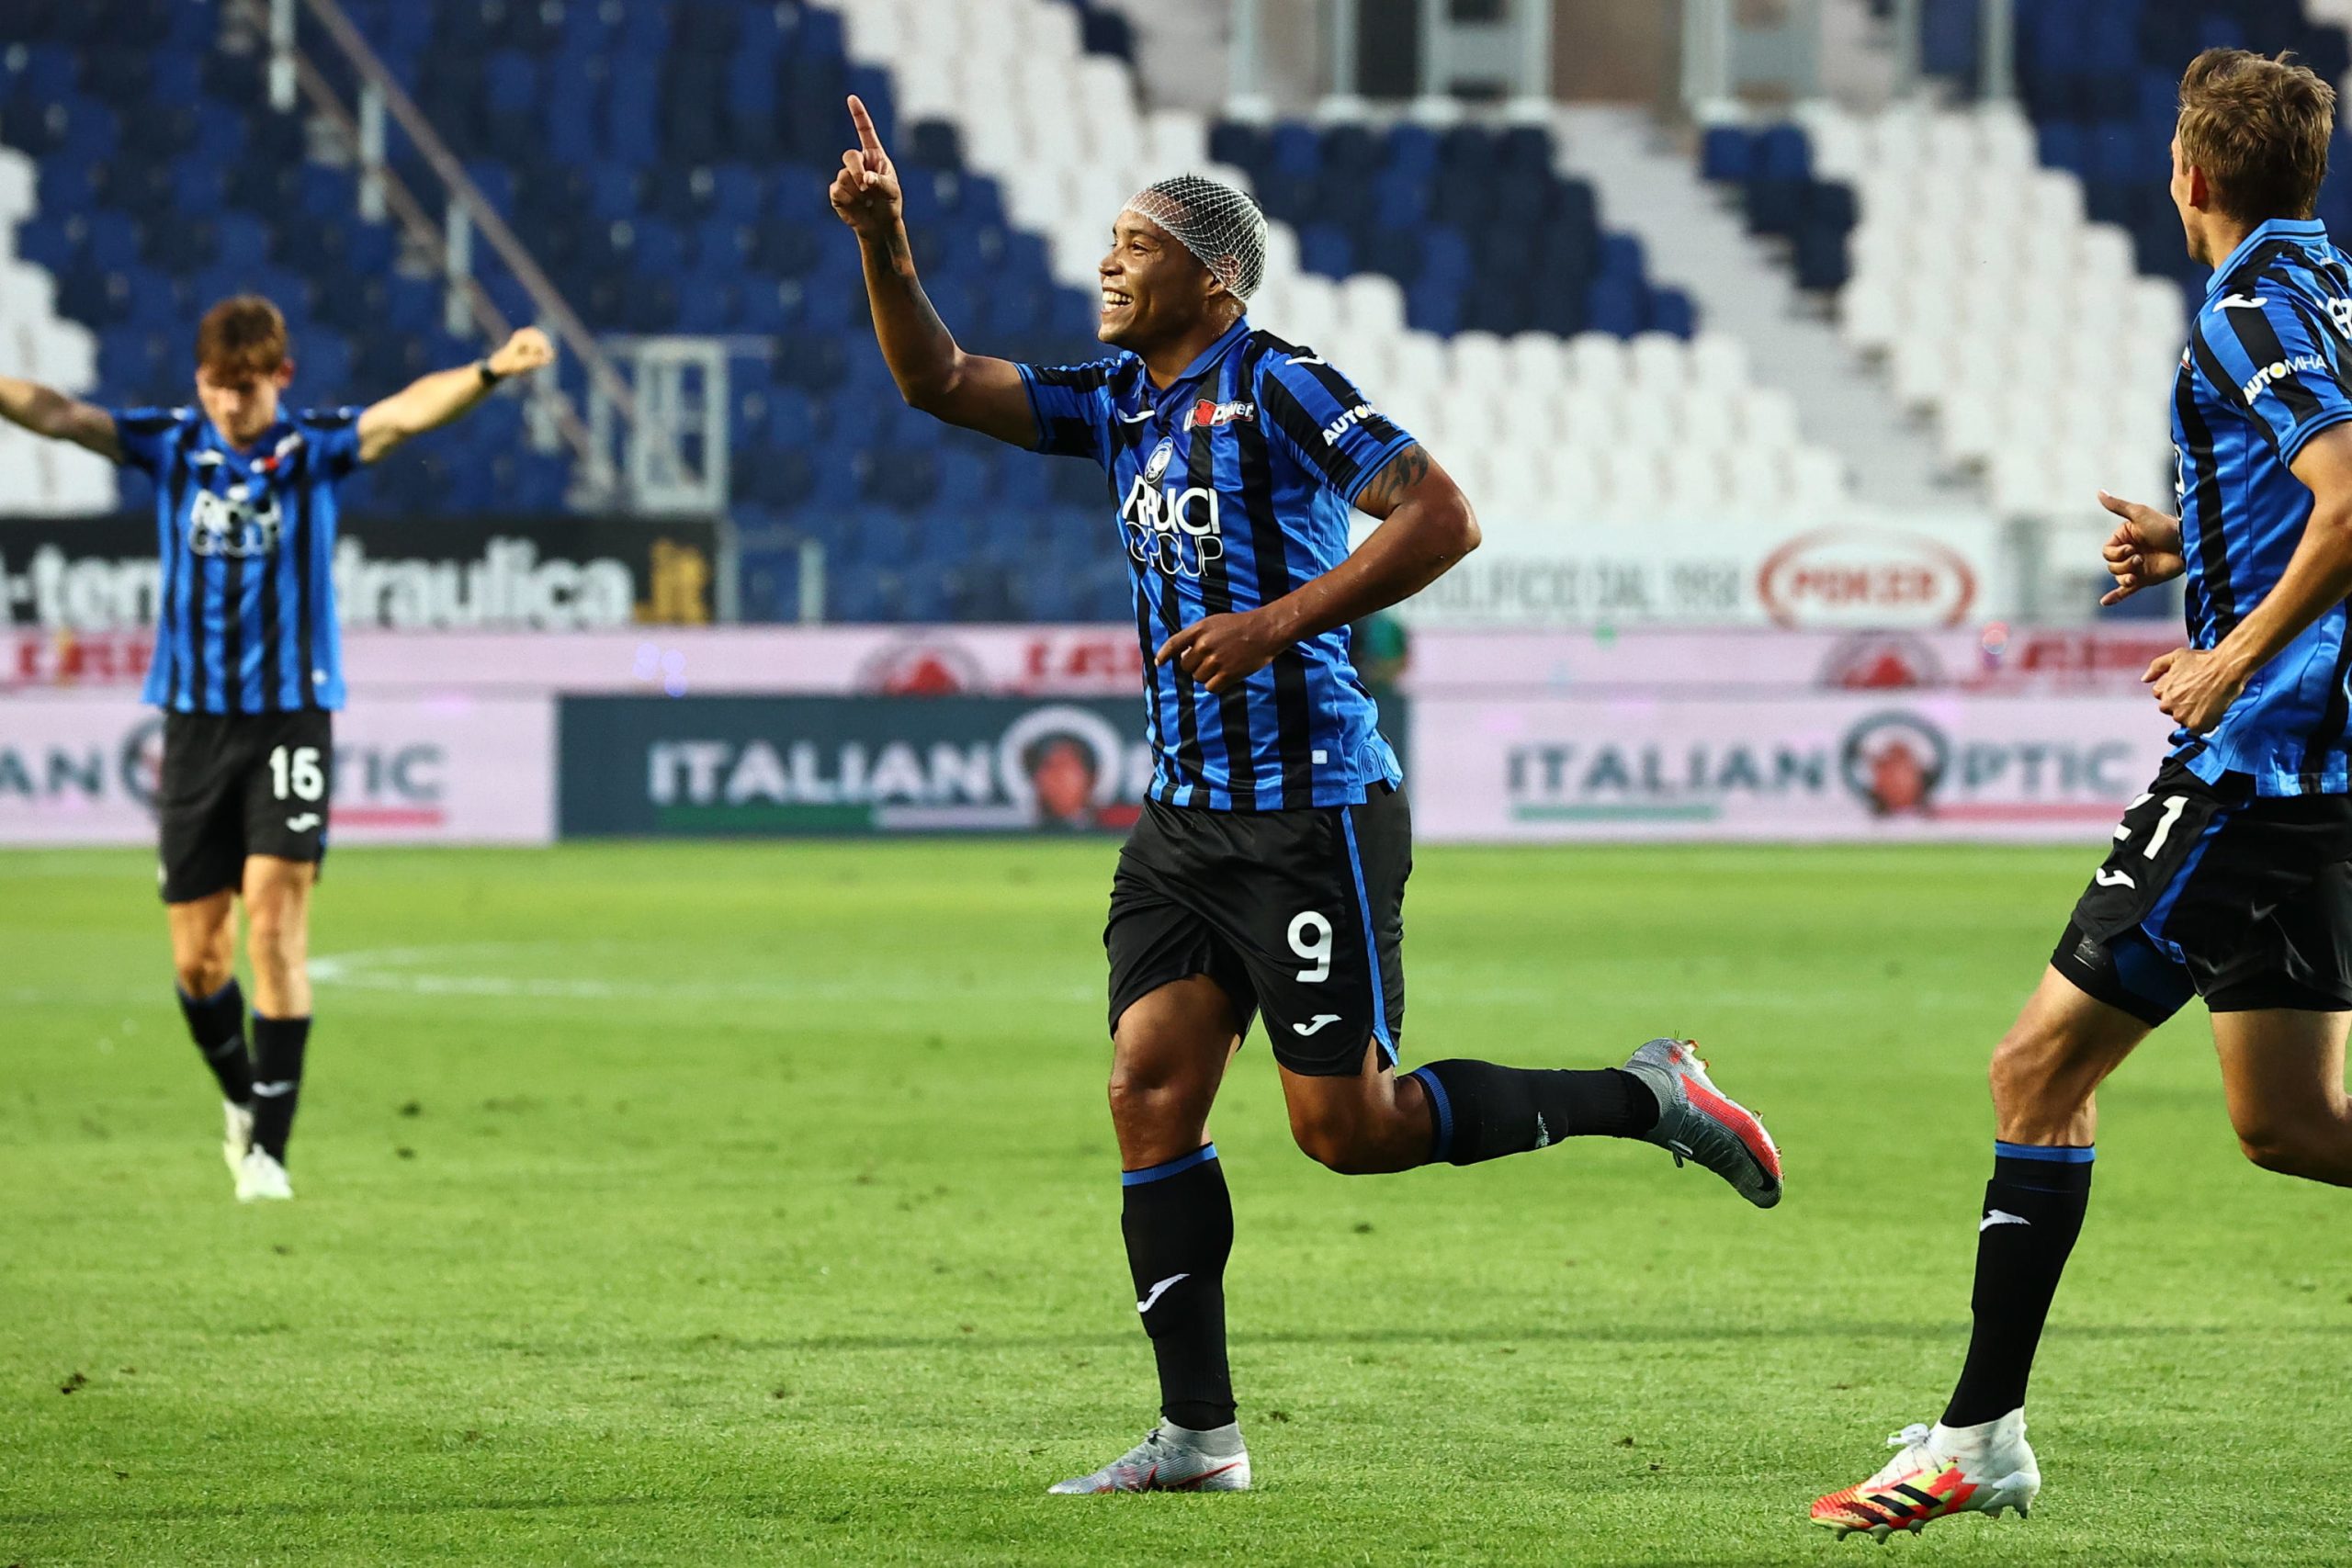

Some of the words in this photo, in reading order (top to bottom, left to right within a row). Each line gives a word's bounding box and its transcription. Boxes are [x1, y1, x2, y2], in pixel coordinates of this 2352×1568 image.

[2242, 354, 2328, 406] AUTOMHA
[269, 745, 324, 802] 16
[648, 739, 994, 805] ITALIAN
[1506, 739, 1829, 794] ITALIAN
[1286, 910, 1333, 983] 9
